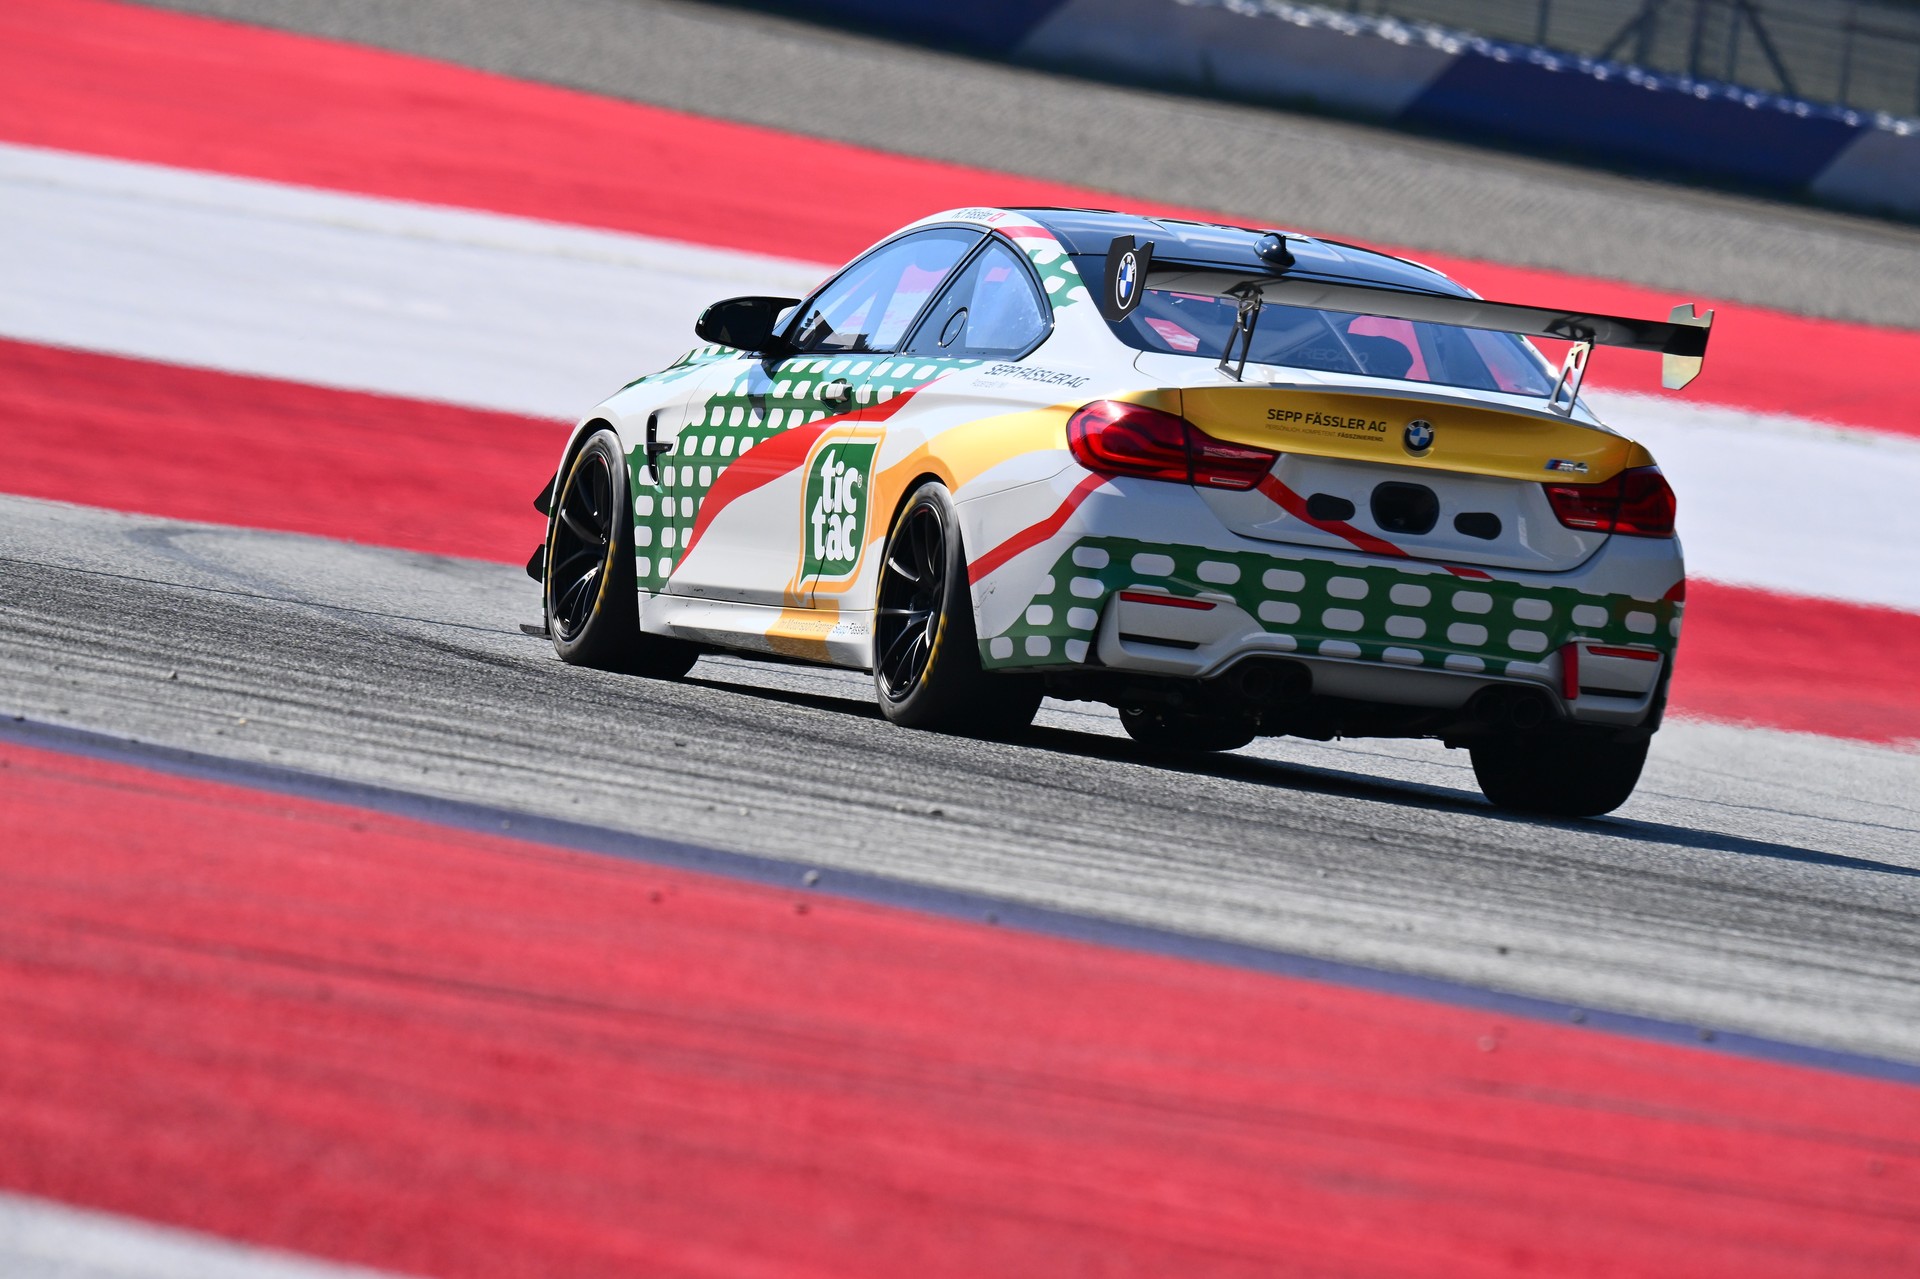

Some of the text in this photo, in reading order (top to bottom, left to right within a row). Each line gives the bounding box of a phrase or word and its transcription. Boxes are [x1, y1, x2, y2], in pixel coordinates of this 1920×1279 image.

[984, 364, 1021, 377] SEPP
[1013, 367, 1072, 384] FÄSSLER
[1060, 376, 1090, 388] AG
[1267, 408, 1387, 433] SEPP FÄSSLER AG
[821, 449, 859, 513] tic
[811, 495, 856, 561] tac
